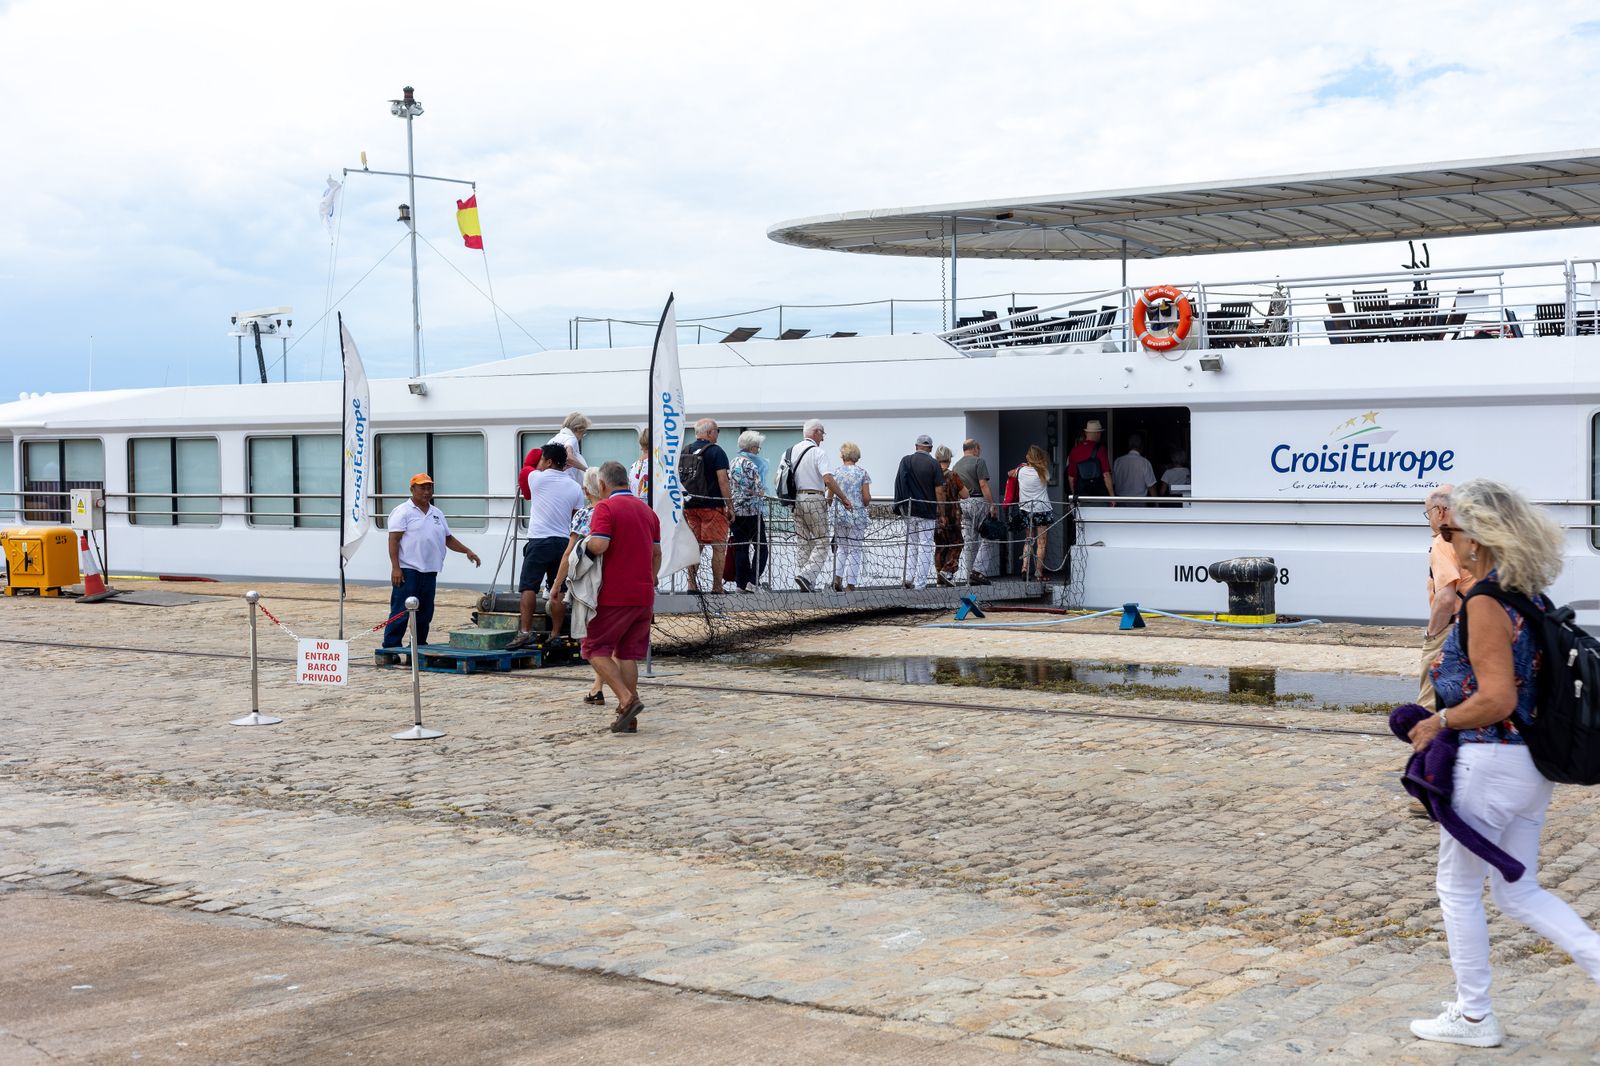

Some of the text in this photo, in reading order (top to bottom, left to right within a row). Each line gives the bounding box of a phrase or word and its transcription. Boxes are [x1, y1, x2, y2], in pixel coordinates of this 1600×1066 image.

[352, 398, 367, 523] CroisiEurope
[1271, 443, 1455, 479] CroisiEurope
[1410, 481, 1441, 489] métie
[55, 535, 68, 545] 25
[1174, 565, 1209, 583] IMO
[316, 641, 330, 650] NO
[305, 652, 340, 661] ENTRAR
[307, 662, 337, 672] BARCO
[302, 673, 342, 683] PRIVADO
